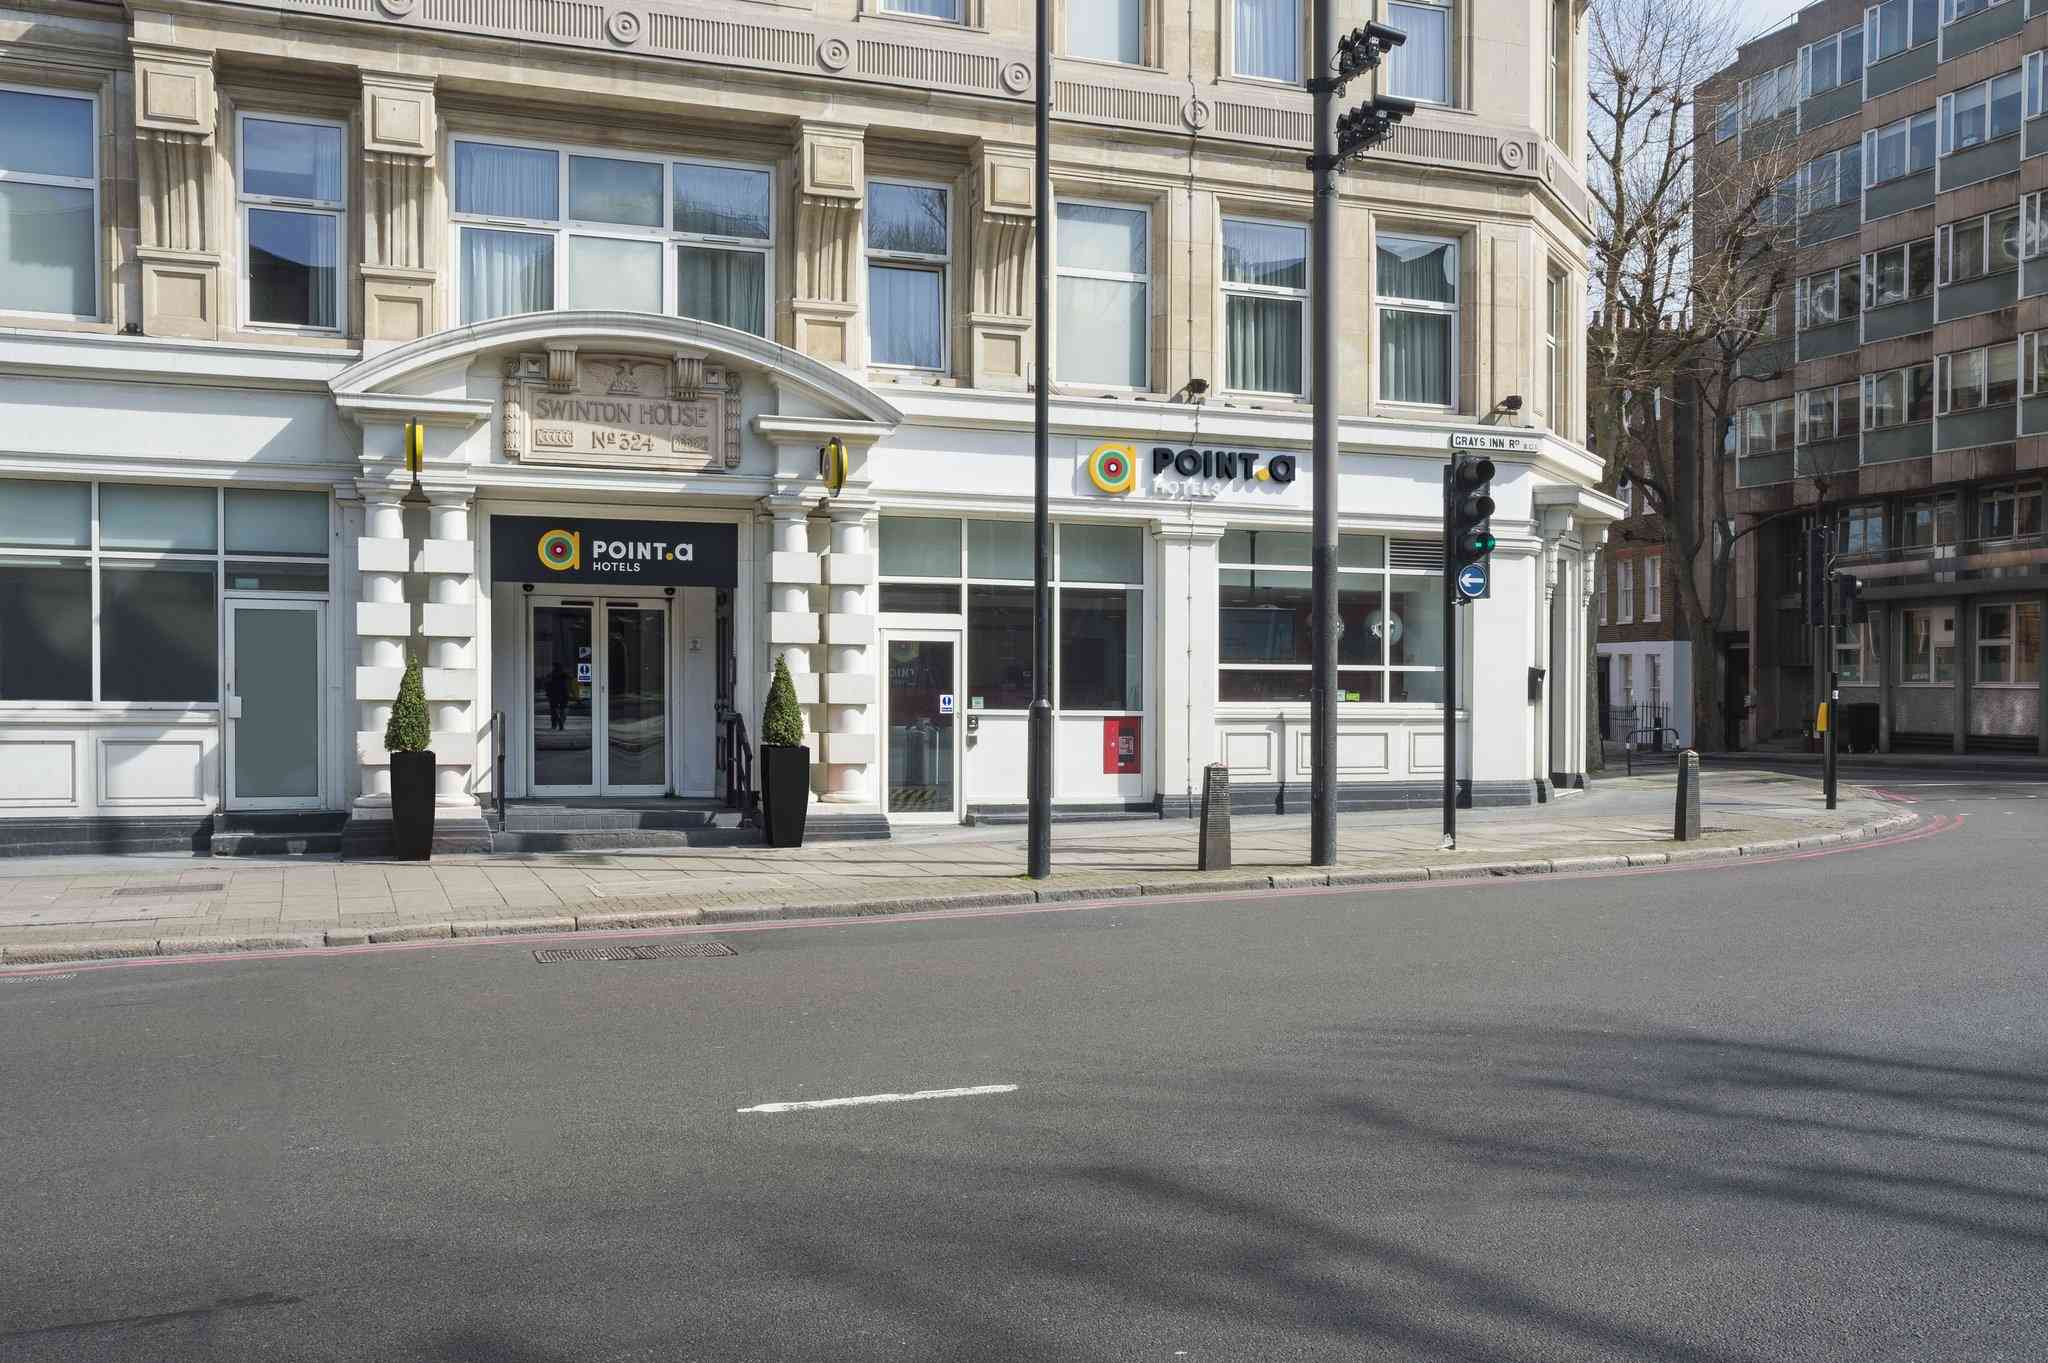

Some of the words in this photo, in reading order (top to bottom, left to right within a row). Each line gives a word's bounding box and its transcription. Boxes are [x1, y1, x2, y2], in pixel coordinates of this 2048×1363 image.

[536, 398, 632, 424] SWINTON
[640, 403, 708, 427] HOUSE
[619, 432, 655, 452] 324
[1455, 436, 1485, 447] GRAYS
[1489, 437, 1504, 448] INN
[592, 561, 641, 573] HOTELS
